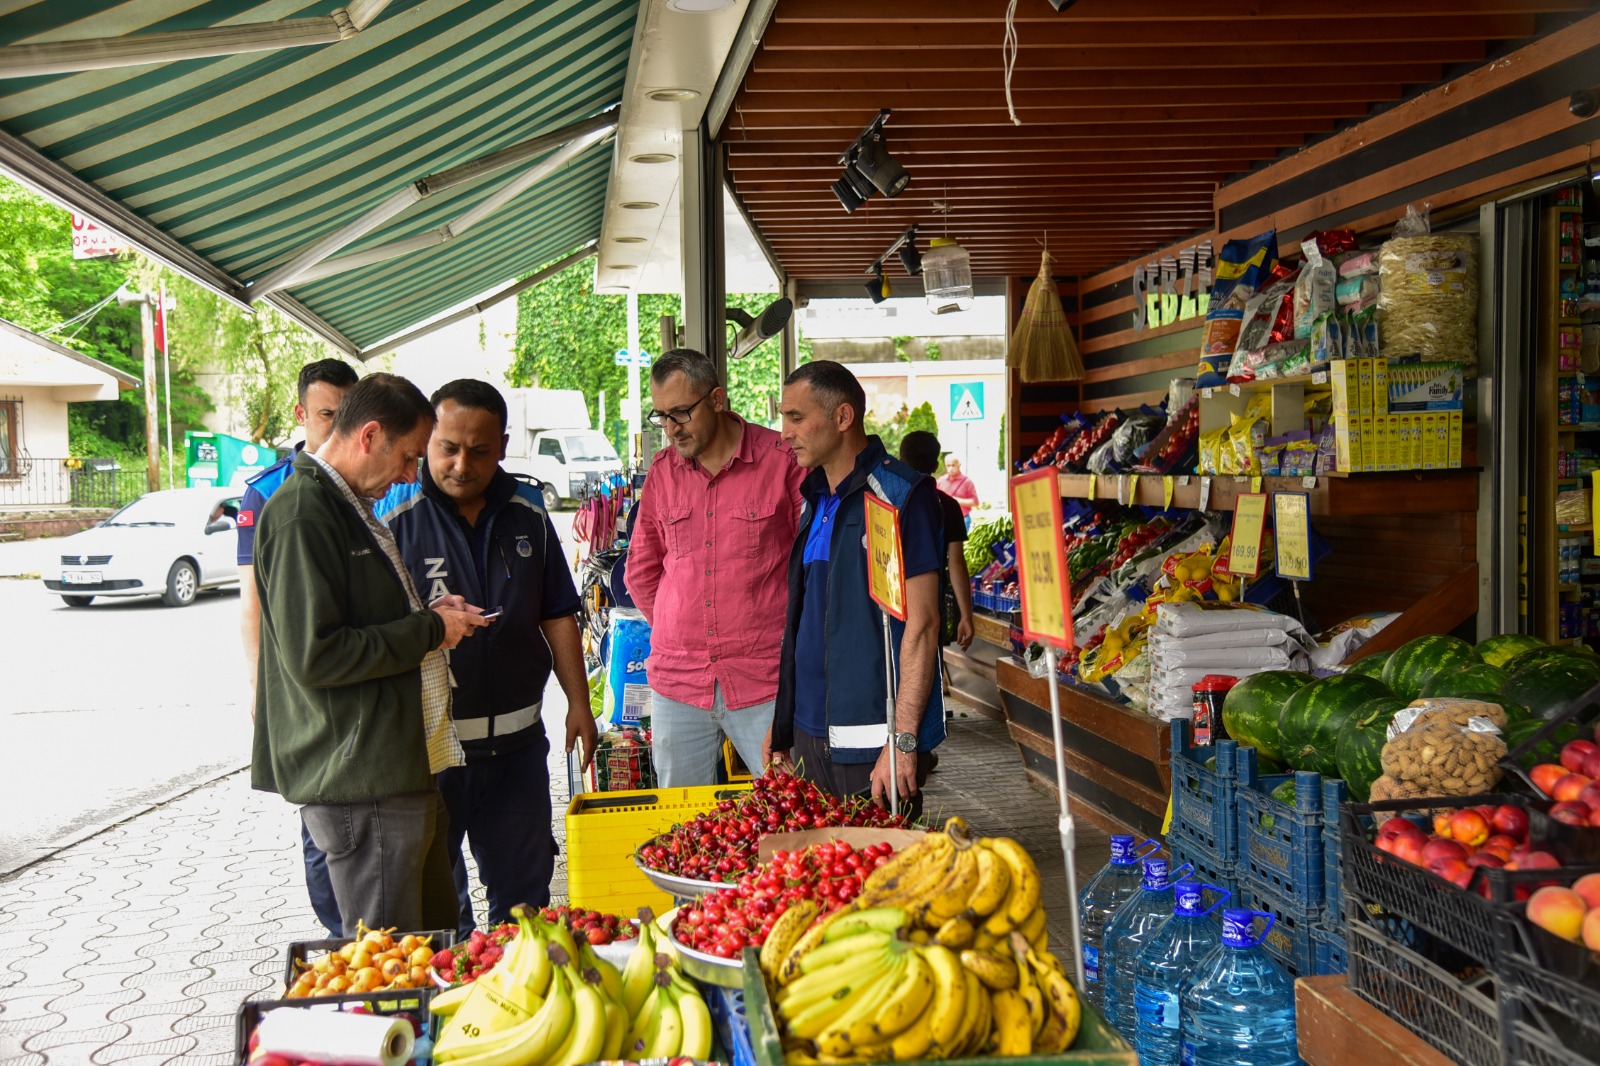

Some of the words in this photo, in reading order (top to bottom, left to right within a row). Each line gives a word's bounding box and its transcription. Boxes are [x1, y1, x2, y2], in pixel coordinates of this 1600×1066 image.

[1133, 239, 1212, 333] SEBZE
[1428, 386, 1448, 396] Family
[1232, 545, 1257, 560] 169,90
[626, 659, 648, 673] Sol
